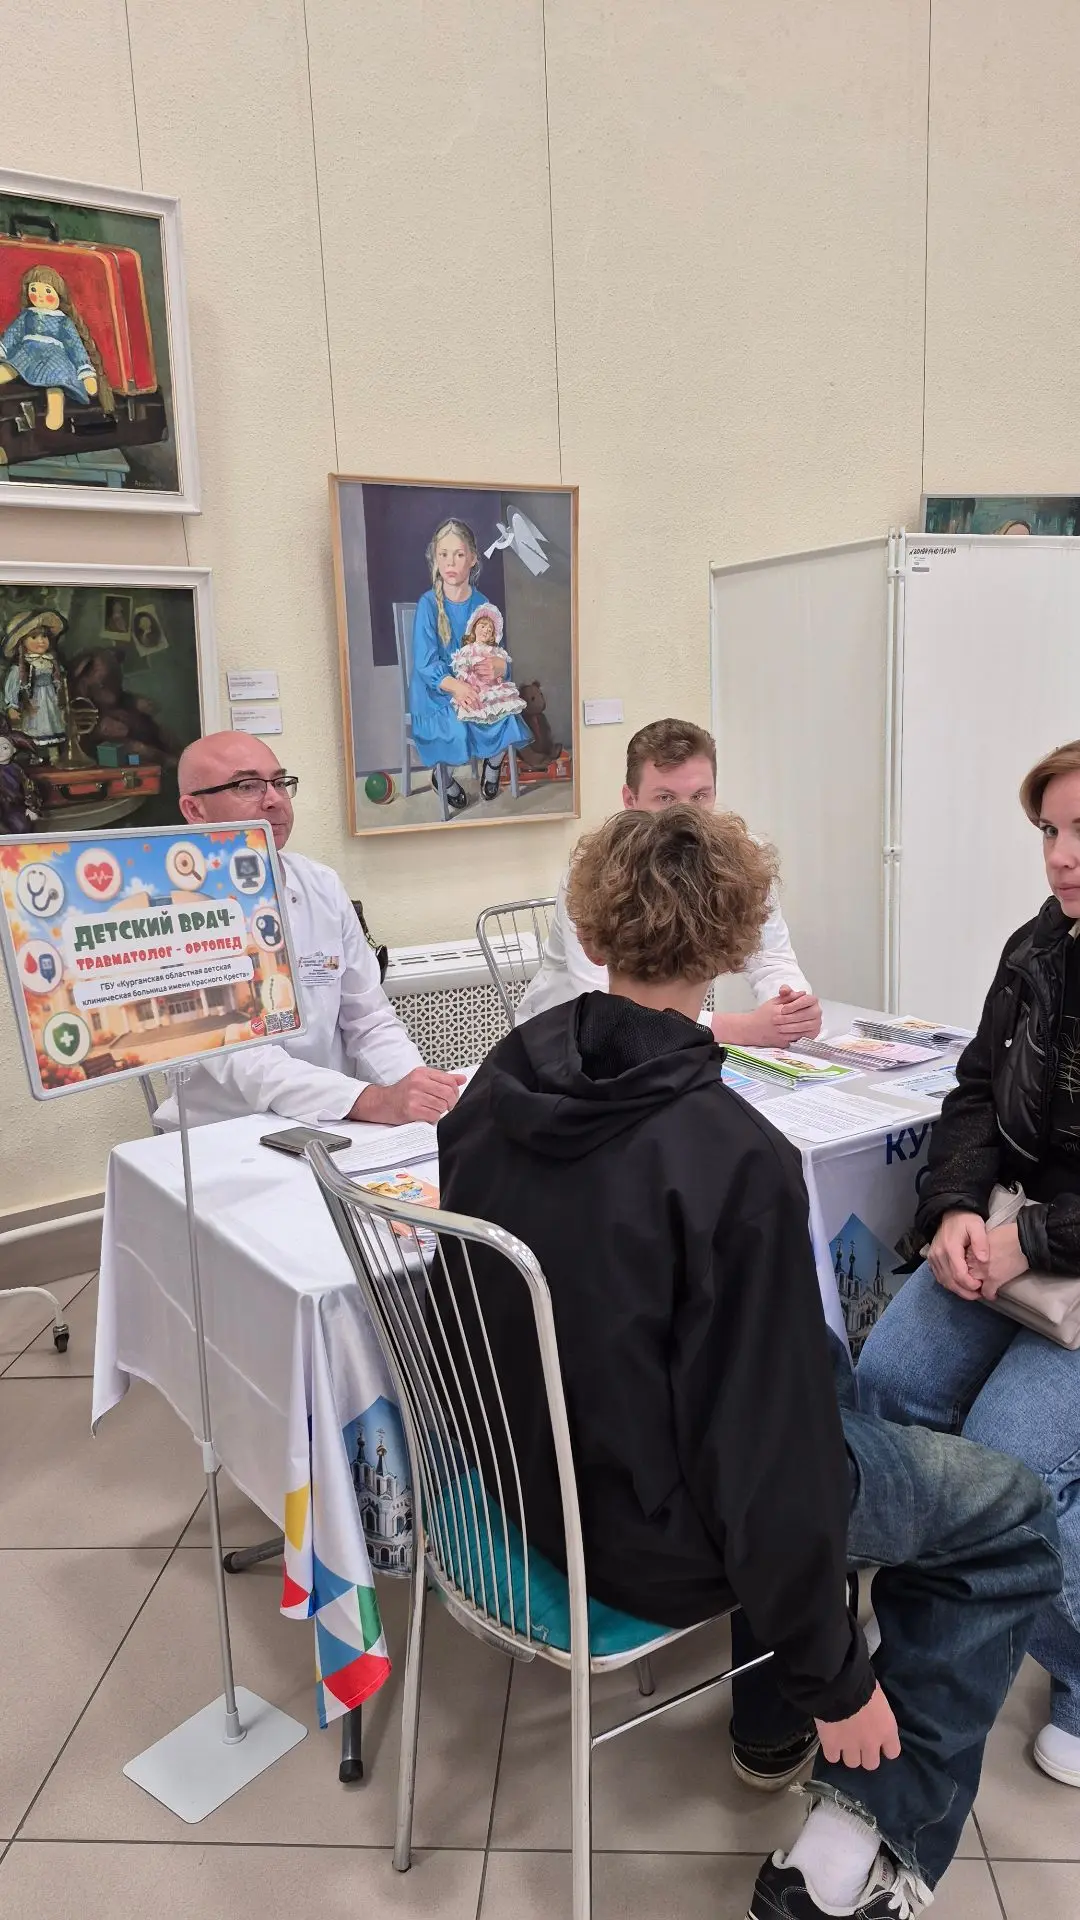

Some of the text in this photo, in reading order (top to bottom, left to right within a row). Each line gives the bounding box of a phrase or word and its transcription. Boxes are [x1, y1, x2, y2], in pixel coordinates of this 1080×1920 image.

[74, 908, 236, 952] ДЕТСКИЙ ВРАЧ-
[76, 945, 173, 970] ТРАВМАТОЛОГ
[186, 936, 243, 954] ОРТОПЕД
[82, 971, 250, 1006] клиническая больница имени Красного Креста»
[100, 963, 232, 991] ГБУ «Курганская областная детская
[886, 1120, 937, 1165] КУ
